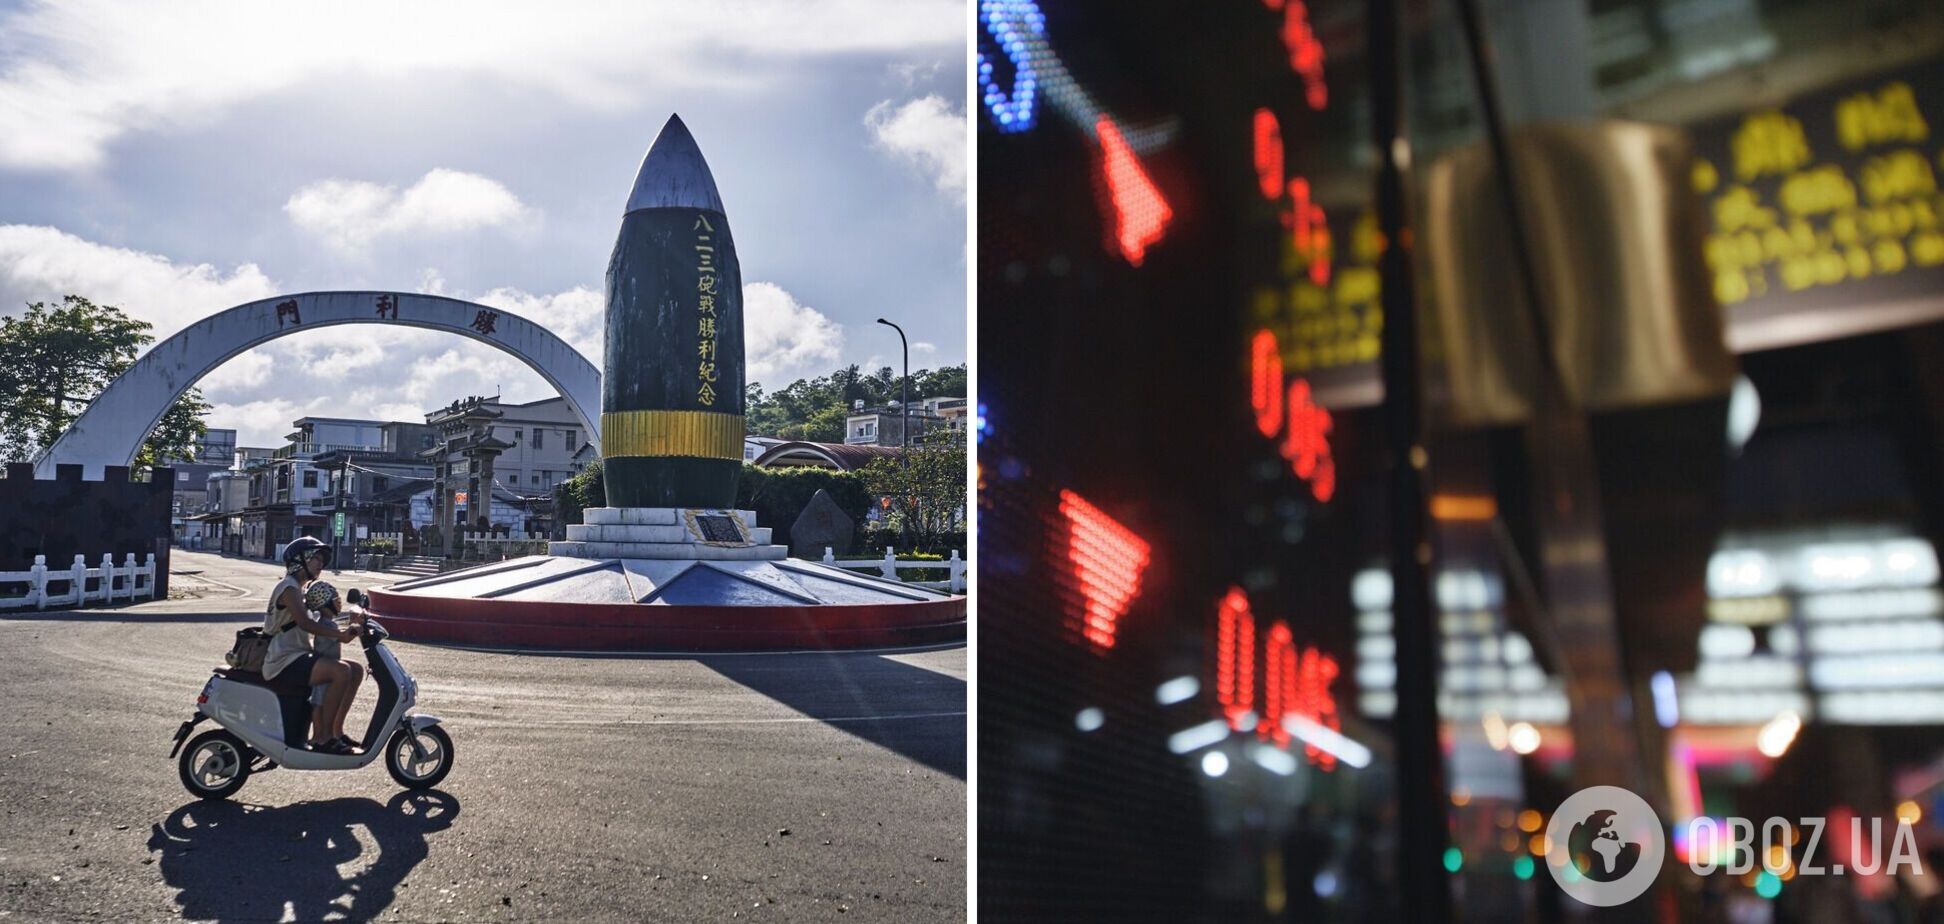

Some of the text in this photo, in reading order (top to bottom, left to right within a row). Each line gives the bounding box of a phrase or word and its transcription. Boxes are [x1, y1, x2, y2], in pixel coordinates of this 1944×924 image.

[693, 214, 717, 406] 八二三砲戰勝利紀念
